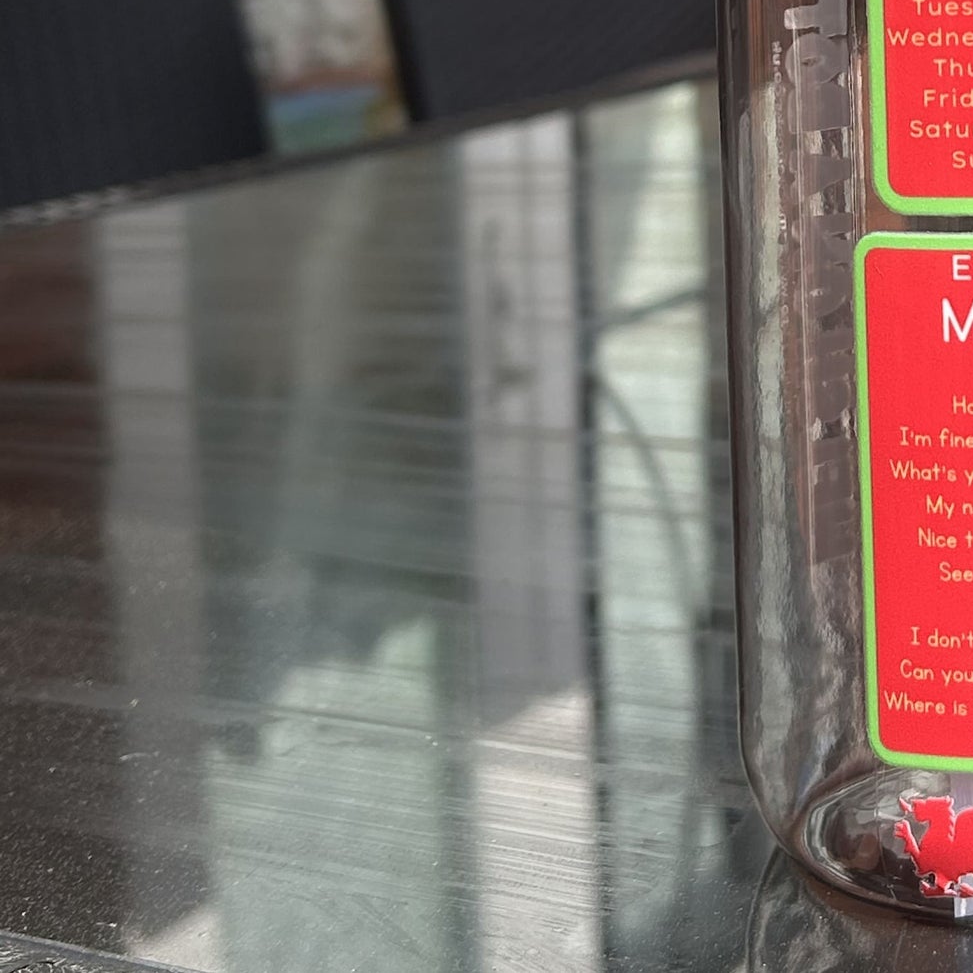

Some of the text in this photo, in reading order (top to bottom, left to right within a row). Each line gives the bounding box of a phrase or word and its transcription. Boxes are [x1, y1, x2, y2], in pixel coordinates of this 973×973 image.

[900, 426, 932, 447] I'm
[889, 459, 957, 482] What's
[926, 494, 955, 520] My
[918, 527, 957, 549] Nice
[939, 561, 973, 582] See
[900, 659, 934, 681] Can
[884, 690, 945, 715] Where
[953, 700, 968, 716] is
